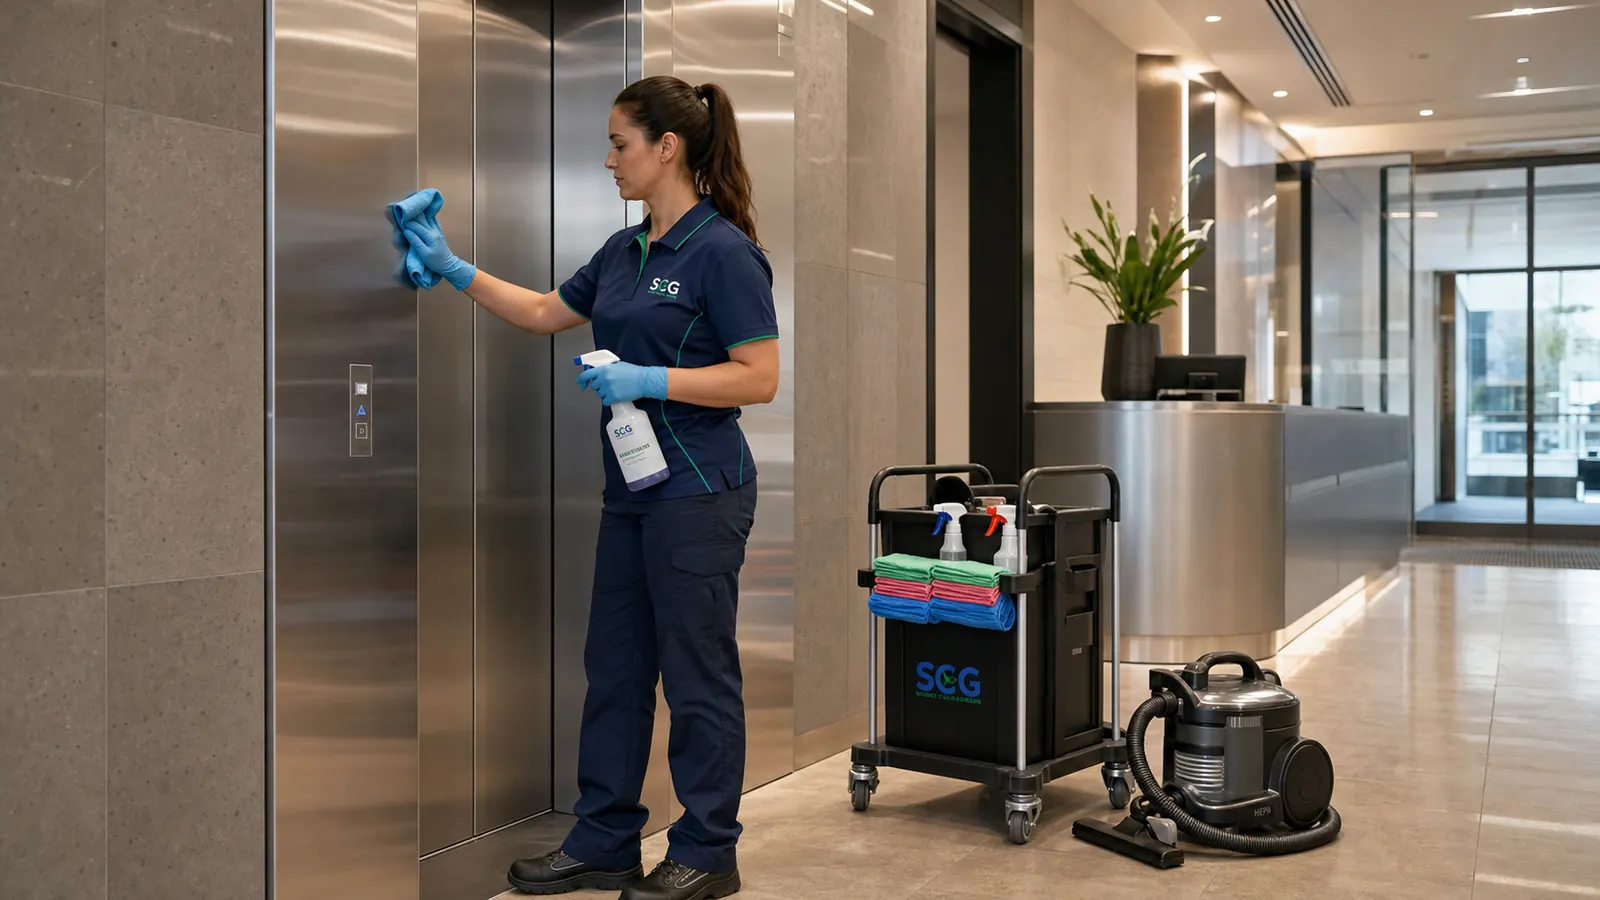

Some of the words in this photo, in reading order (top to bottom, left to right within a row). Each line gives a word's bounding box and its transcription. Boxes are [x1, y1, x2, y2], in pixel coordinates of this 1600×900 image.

[650, 278, 680, 294] SCG
[614, 425, 633, 438] SCG
[916, 661, 981, 697] SCG
